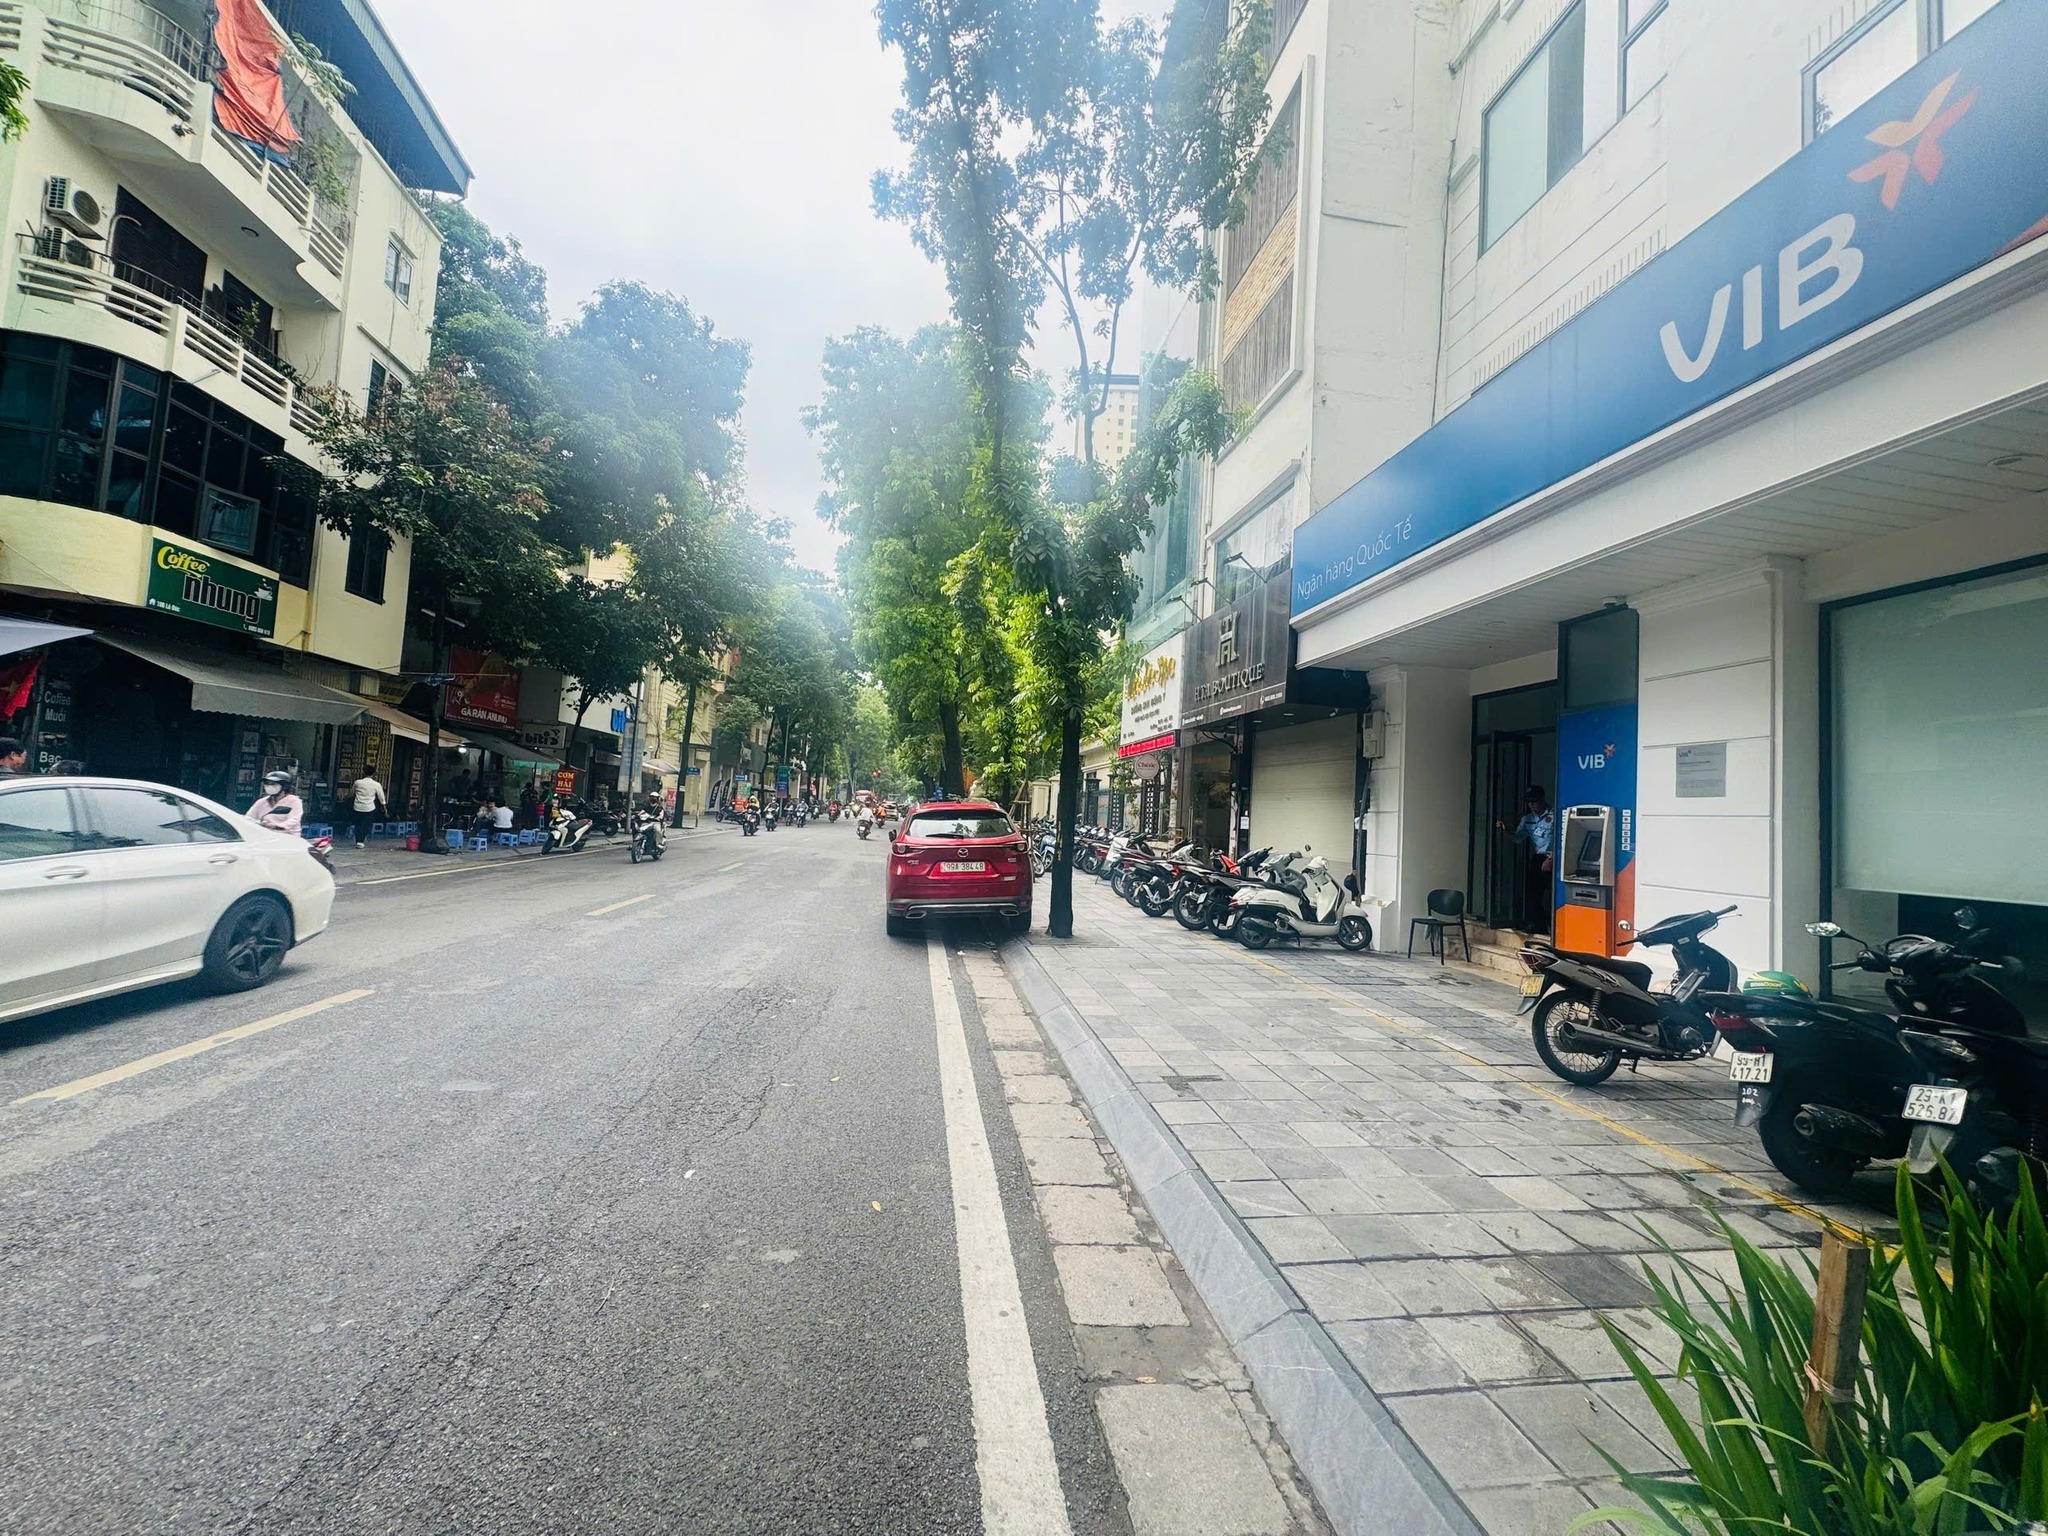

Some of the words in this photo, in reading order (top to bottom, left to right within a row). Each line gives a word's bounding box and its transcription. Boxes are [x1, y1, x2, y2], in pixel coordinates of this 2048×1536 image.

[1659, 213, 1864, 383] VIB
[157, 546, 210, 576] Coffee
[1297, 573, 1323, 600] Ngân
[1325, 556, 1354, 583] hàng
[1356, 530, 1392, 565] Quốc
[1394, 513, 1414, 544] Tế
[182, 574, 261, 624] nhung
[1211, 662, 1265, 695] BOUTIQUE
[44, 691, 71, 705] Coffee
[1578, 754, 1605, 769] VIB
[1731, 1067, 1768, 1081] 417.21
[1907, 1102, 1956, 1121] 526.87
